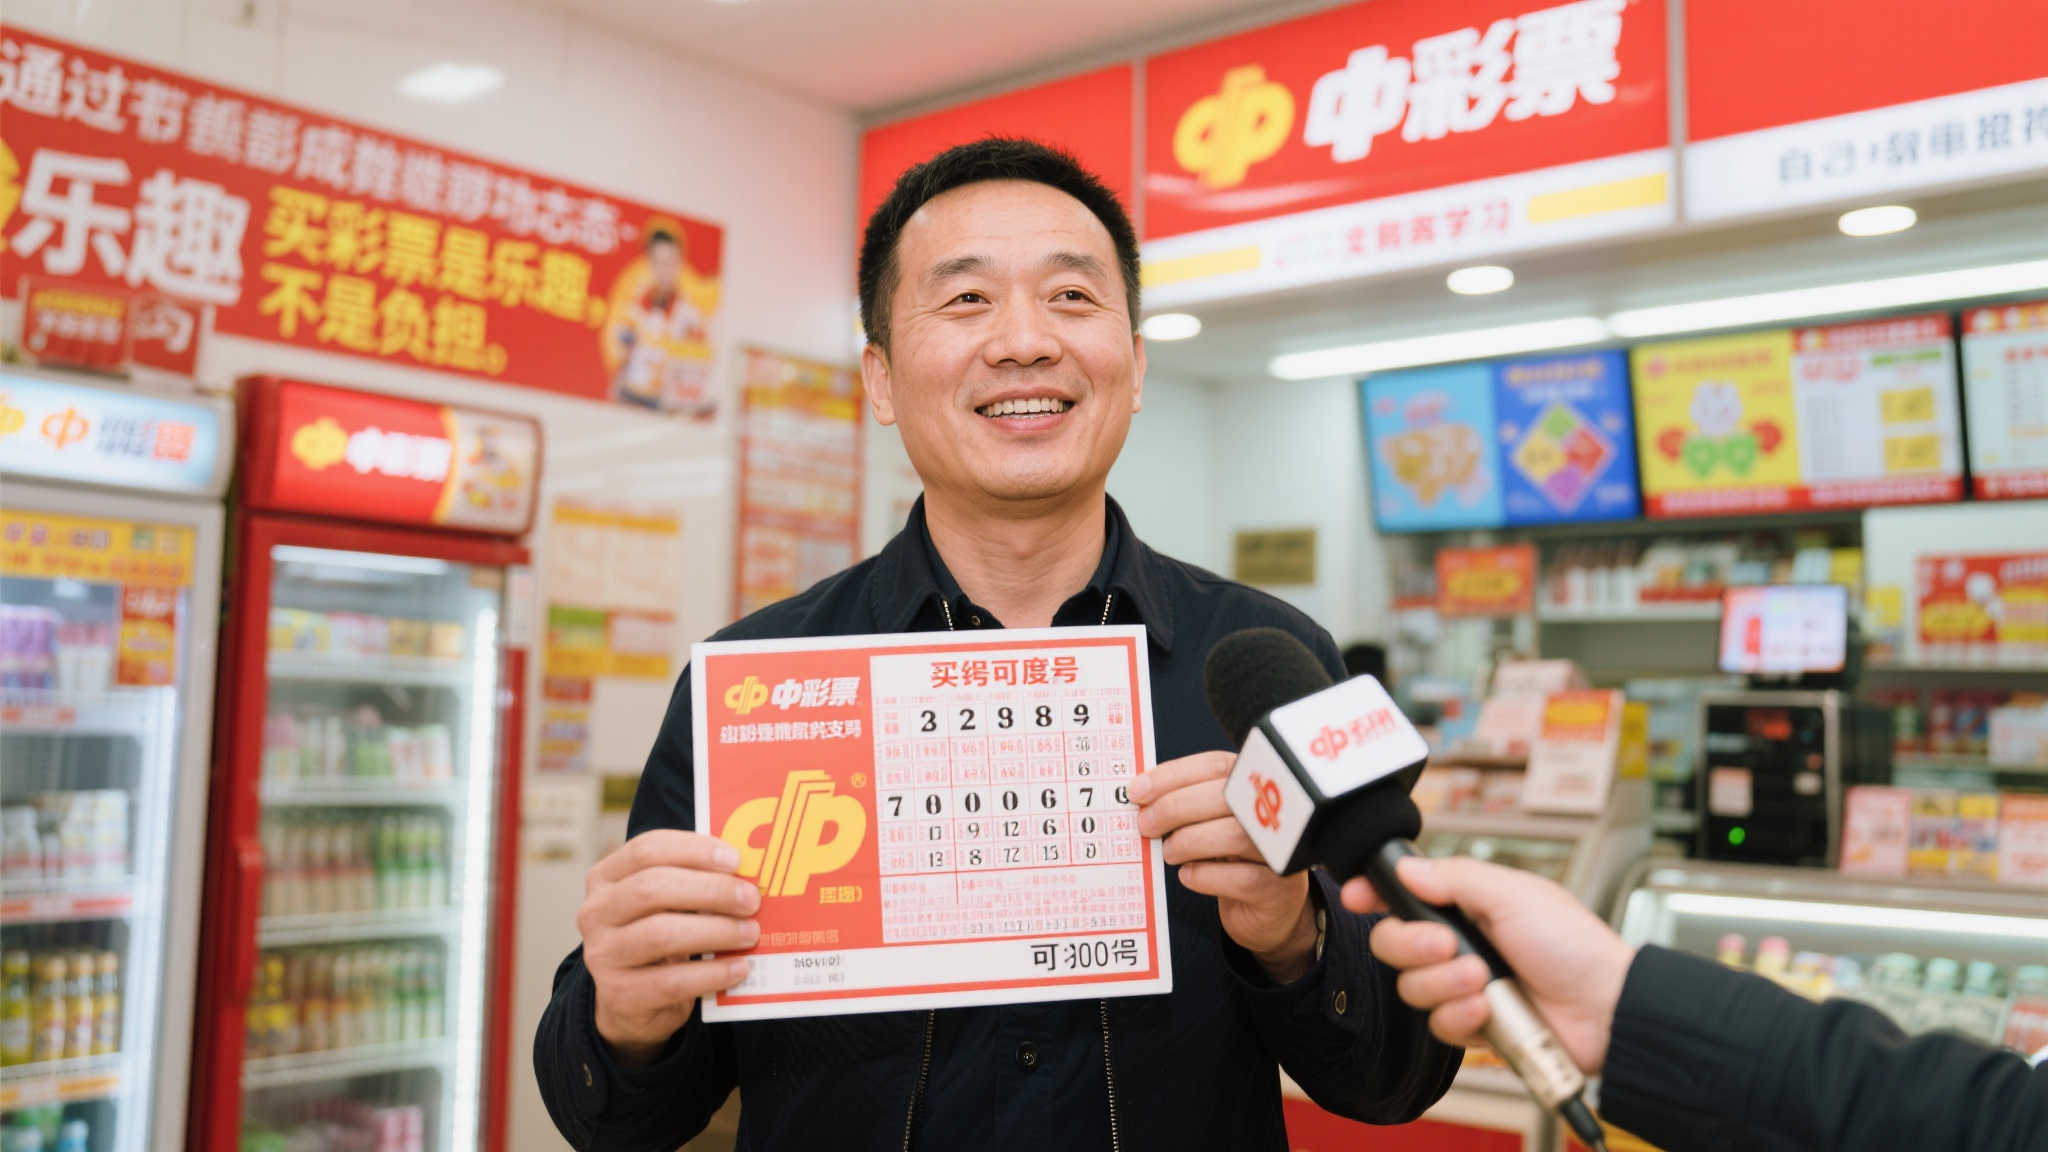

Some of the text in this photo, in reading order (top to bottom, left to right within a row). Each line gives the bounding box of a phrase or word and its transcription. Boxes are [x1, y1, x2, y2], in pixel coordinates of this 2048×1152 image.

[1304, 0, 1626, 164] 中彩票
[10, 147, 252, 306] 乐趣
[770, 676, 861, 710] 中彩票
[959, 708, 976, 731] 2
[1035, 705, 1053, 728] 8
[887, 795, 903, 817] 7
[964, 792, 981, 813] 0
[1003, 791, 1019, 811] 0
[1040, 788, 1057, 809] 6
[1080, 787, 1094, 807] 7
[967, 822, 980, 839] 9
[1004, 820, 1020, 837] 12
[1042, 818, 1057, 835] 6
[1081, 816, 1096, 834] 0
